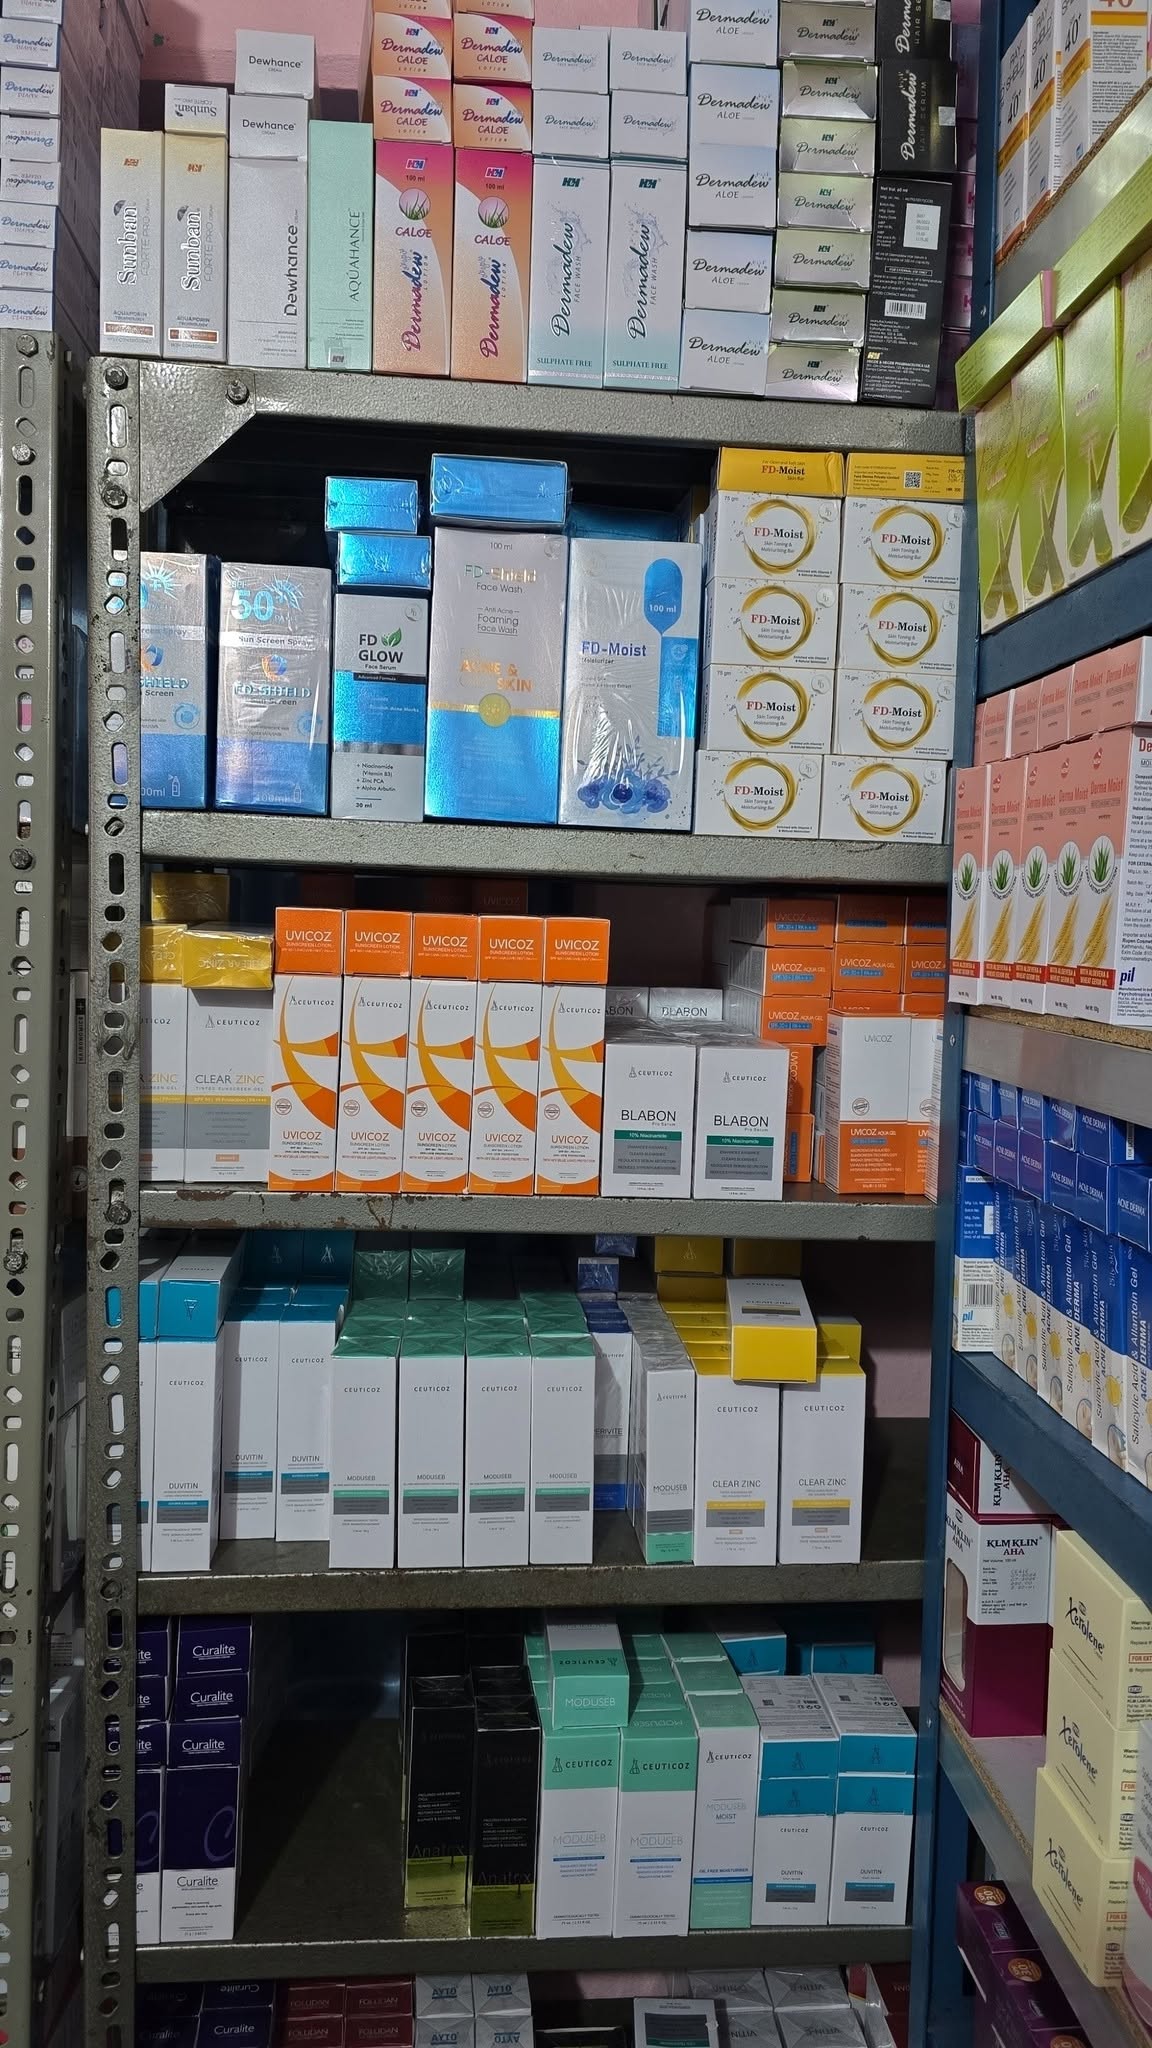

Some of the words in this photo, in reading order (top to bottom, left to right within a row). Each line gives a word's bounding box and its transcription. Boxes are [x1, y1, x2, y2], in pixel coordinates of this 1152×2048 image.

[697, 8, 770, 25] Dermadew
[716, 26, 740, 35] ALOE
[2, 33, 53, 48] Dermadew
[381, 37, 443, 55] Dermadew
[461, 38, 523, 54] Dermadew
[249, 55, 303, 68] Dewhance
[397, 55, 429, 65] CALOE
[477, 54, 508, 64] CALOE
[800, 85, 860, 99] Dermadew
[697, 94, 771, 110] Dermadew
[175, 103, 217, 117] Sunban
[716, 111, 741, 120] ALOE
[901, 70, 918, 161] Dermadew
[242, 119, 296, 131] Dewhance
[396, 116, 428, 126] CALOE
[478, 125, 509, 135] CALOE
[696, 174, 770, 189] Dermadew
[715, 190, 739, 199] ALOE
[395, 227, 432, 238] CALOE
[118, 206, 138, 285] Sunban
[474, 235, 511, 246] CALOE
[181, 211, 201, 291] Sunban
[348, 209, 362, 302] AQUAHANCE
[284, 224, 298, 316] Dewhance
[693, 259, 766, 276] Dermadew
[552, 223, 574, 337] Dermadew
[628, 224, 650, 338] Dermadew
[711, 276, 735, 285] ALOE
[402, 251, 423, 352] Dermadew
[480, 258, 500, 358] Dermadew
[689, 337, 762, 356] Dermadew
[537, 357, 572, 367] SULPHATE
[575, 359, 592, 367] FREE
[612, 359, 648, 368] SULPHATE
[650, 361, 668, 369] FREE
[707, 356, 730, 365] ALOE
[761, 465, 805, 475] FD-Moist
[753, 527, 804, 539] FD-Moist
[879, 534, 931, 545] FD-Moist
[503, 542, 512, 550] ml
[476, 582, 496, 592] Face
[499, 584, 522, 594] Wash
[231, 589, 272, 621] 50
[649, 604, 663, 612] 100
[666, 604, 676, 612] ml
[478, 614, 519, 626] Foaming
[751, 614, 801, 626] FD-Moist
[478, 624, 495, 633] Face
[497, 624, 518, 634] Wash
[878, 620, 927, 633] FD-Moist
[359, 634, 378, 646] FD
[582, 641, 646, 656] FD-Moist
[358, 649, 403, 664] GLOW
[497, 679, 531, 692] SKIN
[746, 700, 796, 712] FD-Moist
[872, 706, 922, 717] FD-Moist
[734, 786, 784, 796] FD-Moist
[1090, 784, 1106, 794] Derma
[1107, 779, 1122, 792] Moist
[860, 791, 909, 801] FD-Moist
[1059, 790, 1074, 802] Derma
[1074, 788, 1089, 801] Moist
[286, 930, 332, 942] UVICOZ
[354, 931, 401, 943] UVICOZ
[422, 935, 468, 947] UVICOZ
[489, 938, 533, 950] UVICOZ
[555, 940, 599, 951] UVICOZ
[1119, 967, 1135, 985] pil
[769, 1011, 800, 1021] UVICOZ
[150, 1074, 177, 1083] ZINC
[195, 1074, 231, 1084] CLEAR
[236, 1074, 264, 1084] ZINC
[621, 1110, 676, 1121] BLABON
[714, 1116, 769, 1126] BLABON
[283, 1131, 321, 1140] UVICOZ
[351, 1131, 389, 1141] UVICOZ
[418, 1132, 456, 1143] UVICOZ
[485, 1134, 522, 1143] UVICOZ
[551, 1135, 588, 1144] UVICOZ
[1130, 1268, 1138, 1284] Gel
[1130, 1286, 1139, 1339] Allantoin
[1139, 1320, 1147, 1369] DERMA
[1132, 1360, 1140, 1387] Acid
[1140, 1372, 1148, 1401] ACNE
[1132, 1390, 1140, 1444] Salicylic
[291, 1455, 320, 1463] DUVITIN
[169, 1482, 198, 1490] DUVITIN
[712, 1480, 739, 1488] CLEAR
[741, 1480, 760, 1488] ZINC
[798, 1478, 825, 1486] CLEAR
[827, 1478, 846, 1486] ZINC
[952, 1535, 964, 1552] AHA
[1012, 1538, 1038, 1547] KLIN
[192, 1643, 236, 1657] Curalite
[190, 1690, 233, 1704] Curalite
[565, 1697, 616, 1707] MODUSEB
[182, 1738, 225, 1751] Curalite
[566, 1759, 613, 1768] CEUTICOZ
[643, 1763, 690, 1771] CEUTICOZ
[715, 1813, 737, 1821] MOIST
[553, 1834, 606, 1845] MODUSEB
[177, 1874, 218, 1888] Curalite
[214, 2023, 255, 2035] Curalite
